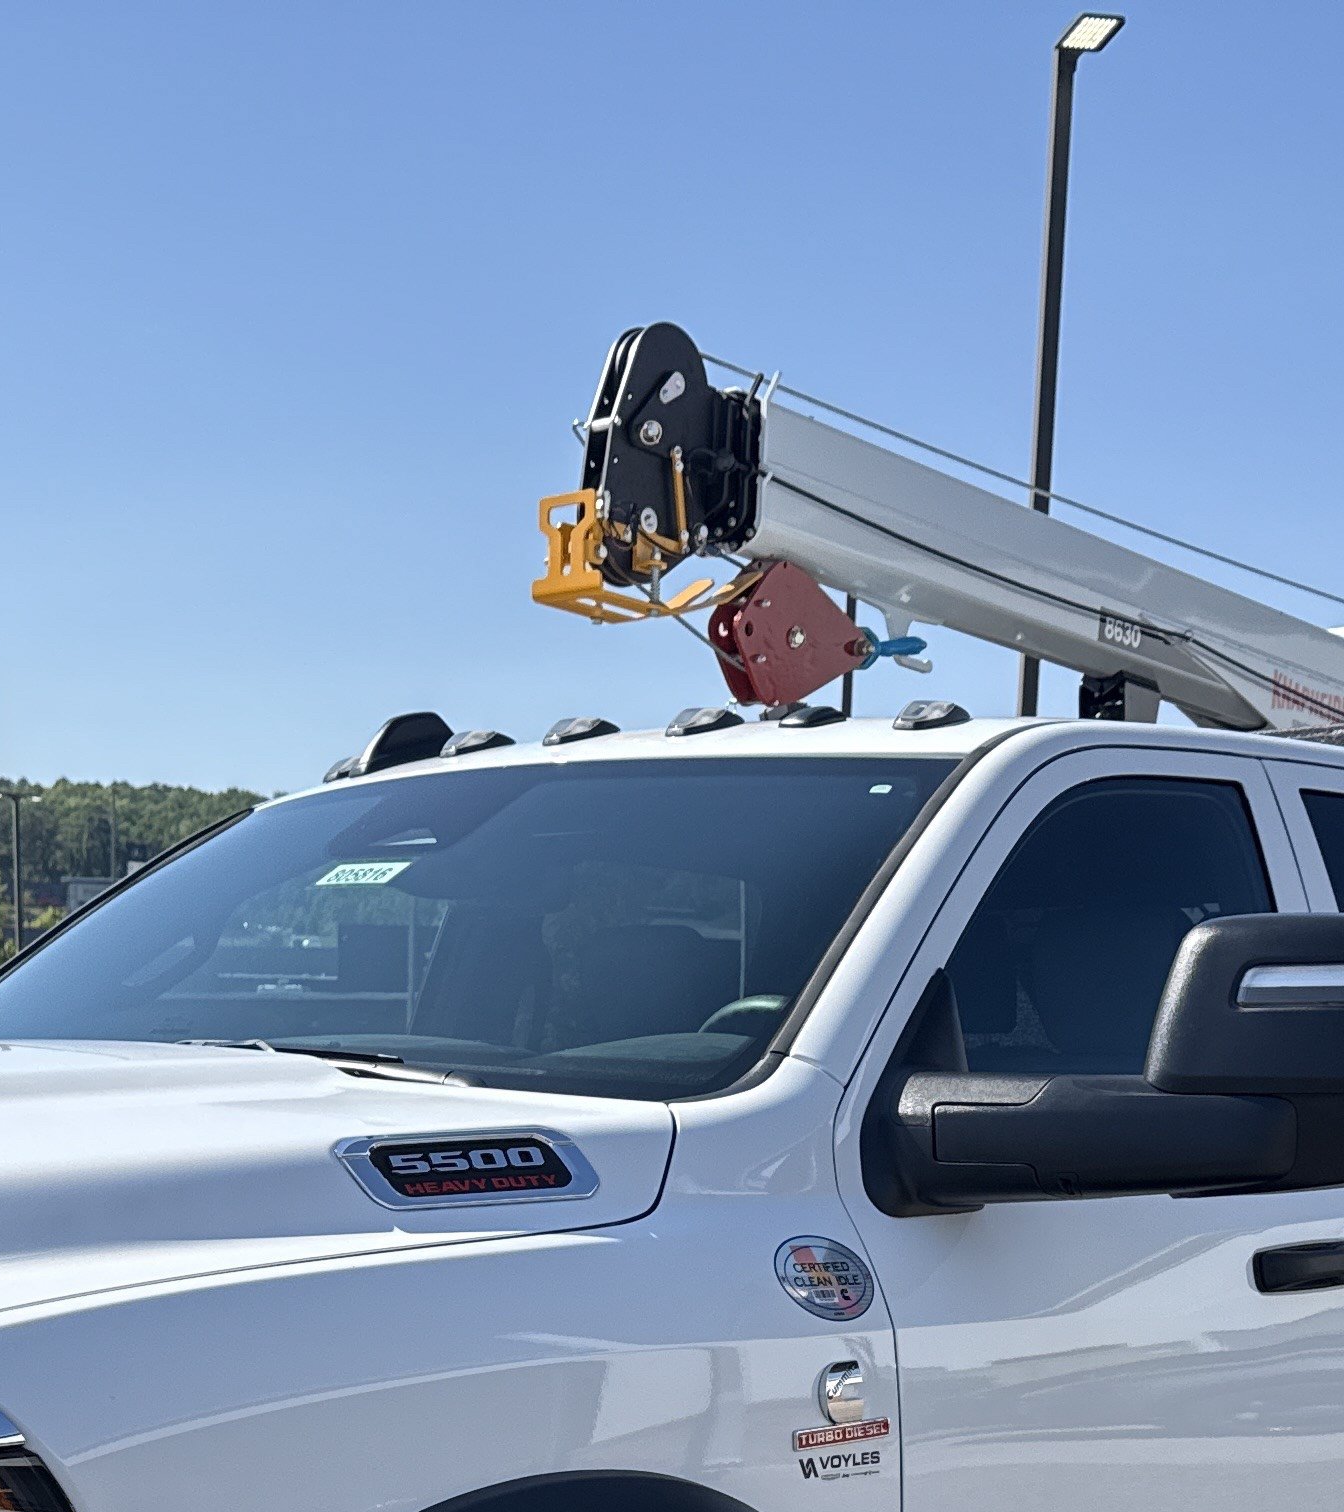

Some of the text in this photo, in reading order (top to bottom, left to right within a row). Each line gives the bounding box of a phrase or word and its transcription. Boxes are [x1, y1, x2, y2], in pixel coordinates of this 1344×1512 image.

[1104, 617, 1141, 648] 8630
[389, 1146, 545, 1174] 5500
[404, 1174, 557, 1195] HEAVY DUTY
[793, 1262, 850, 1273] CERTIFIED
[794, 1274, 863, 1287] CLEAN IDLE
[799, 1422, 888, 1446] TURBO DIESEL
[819, 1451, 881, 1470] VOYLES
